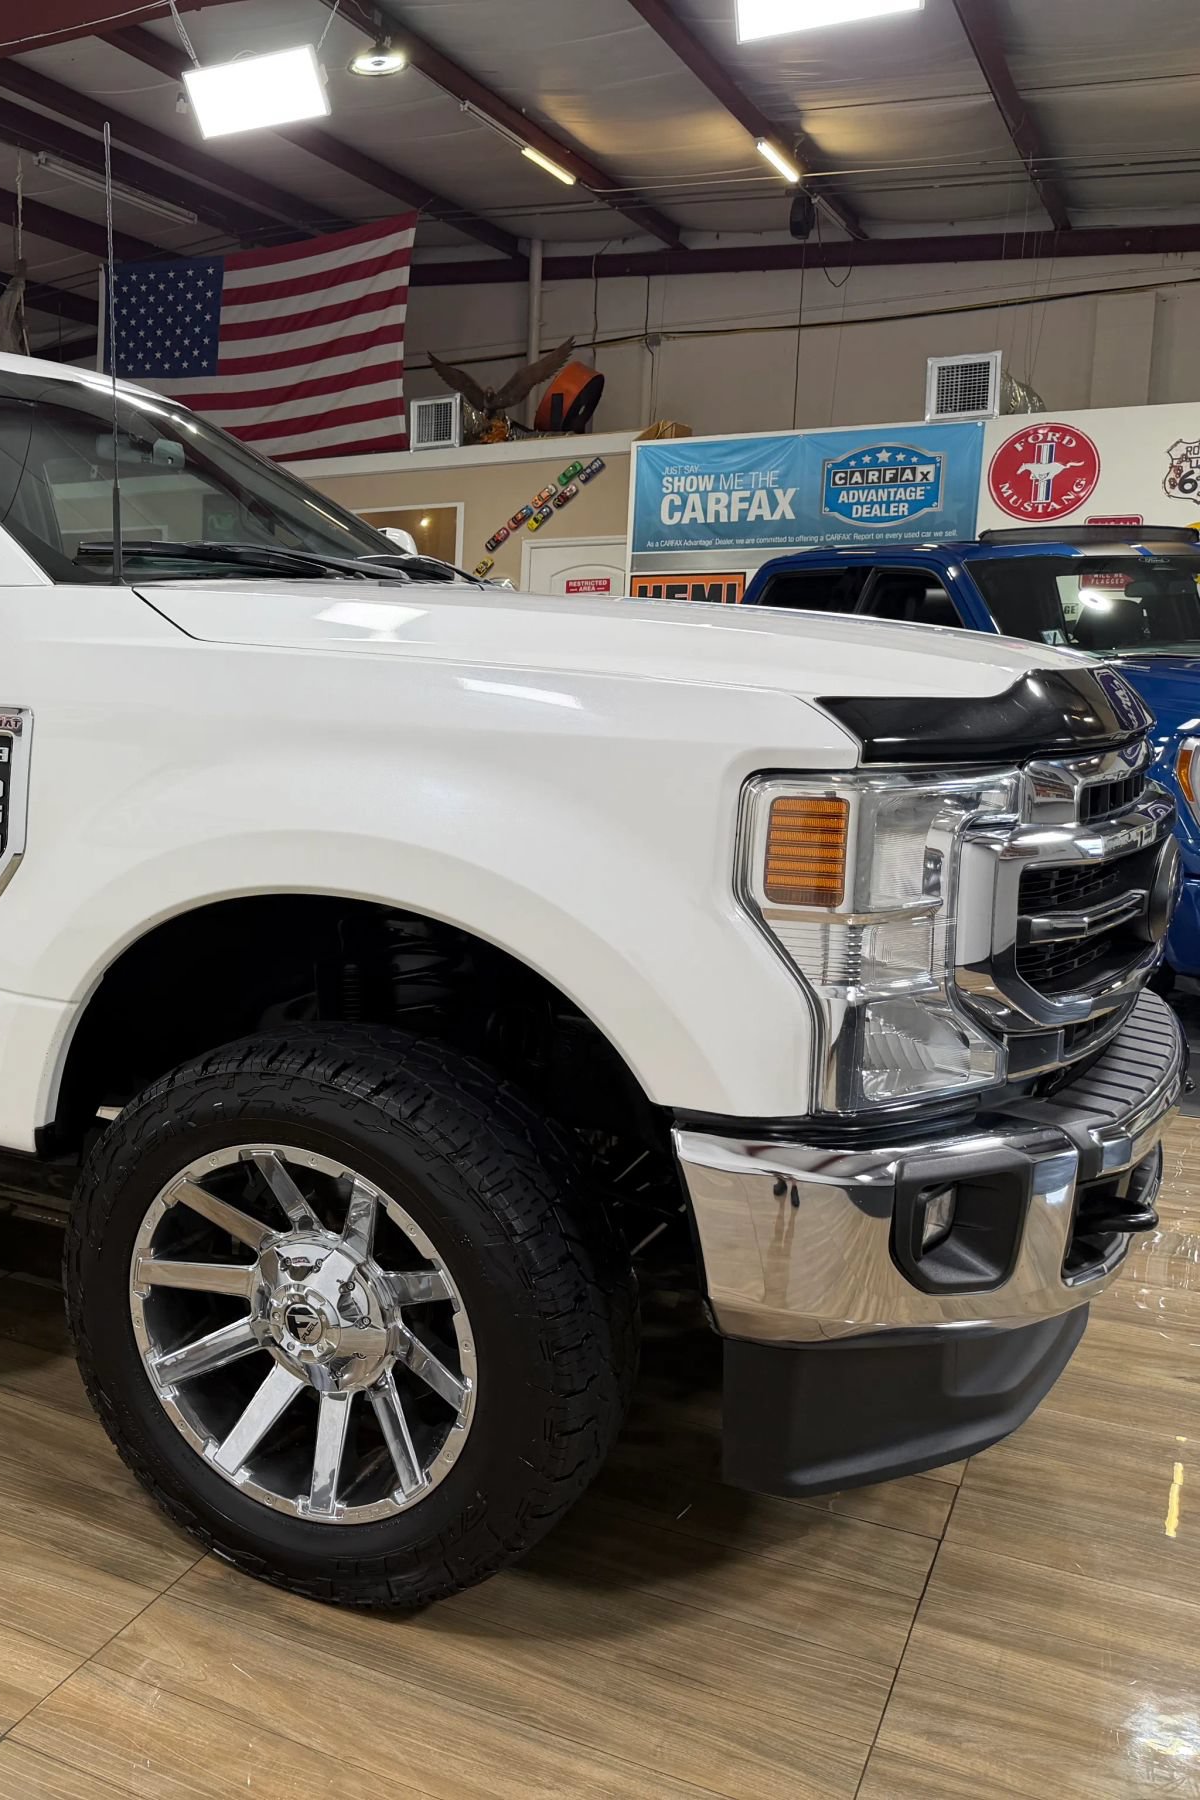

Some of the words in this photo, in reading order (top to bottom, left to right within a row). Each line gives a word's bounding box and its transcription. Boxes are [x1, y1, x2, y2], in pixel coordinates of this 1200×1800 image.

[1013, 431, 1077, 452] FORD
[662, 466, 683, 475] JUST
[684, 464, 700, 474] SAY
[834, 468, 931, 485] CARFAX
[662, 474, 715, 494] SHOW
[719, 472, 744, 490] ME
[749, 470, 779, 489] THE
[838, 487, 925, 504] ADVANTAGE
[999, 477, 1087, 514] MUSTANG
[660, 487, 797, 526] CARFAX
[852, 502, 909, 518] DEALER
[660, 539, 683, 547] CARFAX
[683, 538, 712, 547] Advantage
[745, 537, 755, 545] are
[756, 535, 787, 544] committed
[788, 535, 794, 543] to
[795, 533, 818, 543] offering
[825, 533, 850, 541] CARFAX
[853, 532, 874, 541] Report
[885, 532, 902, 541] every
[904, 530, 919, 538] used
[944, 529, 958, 537] sell.
[300, 1320, 319, 1342] FUEL
